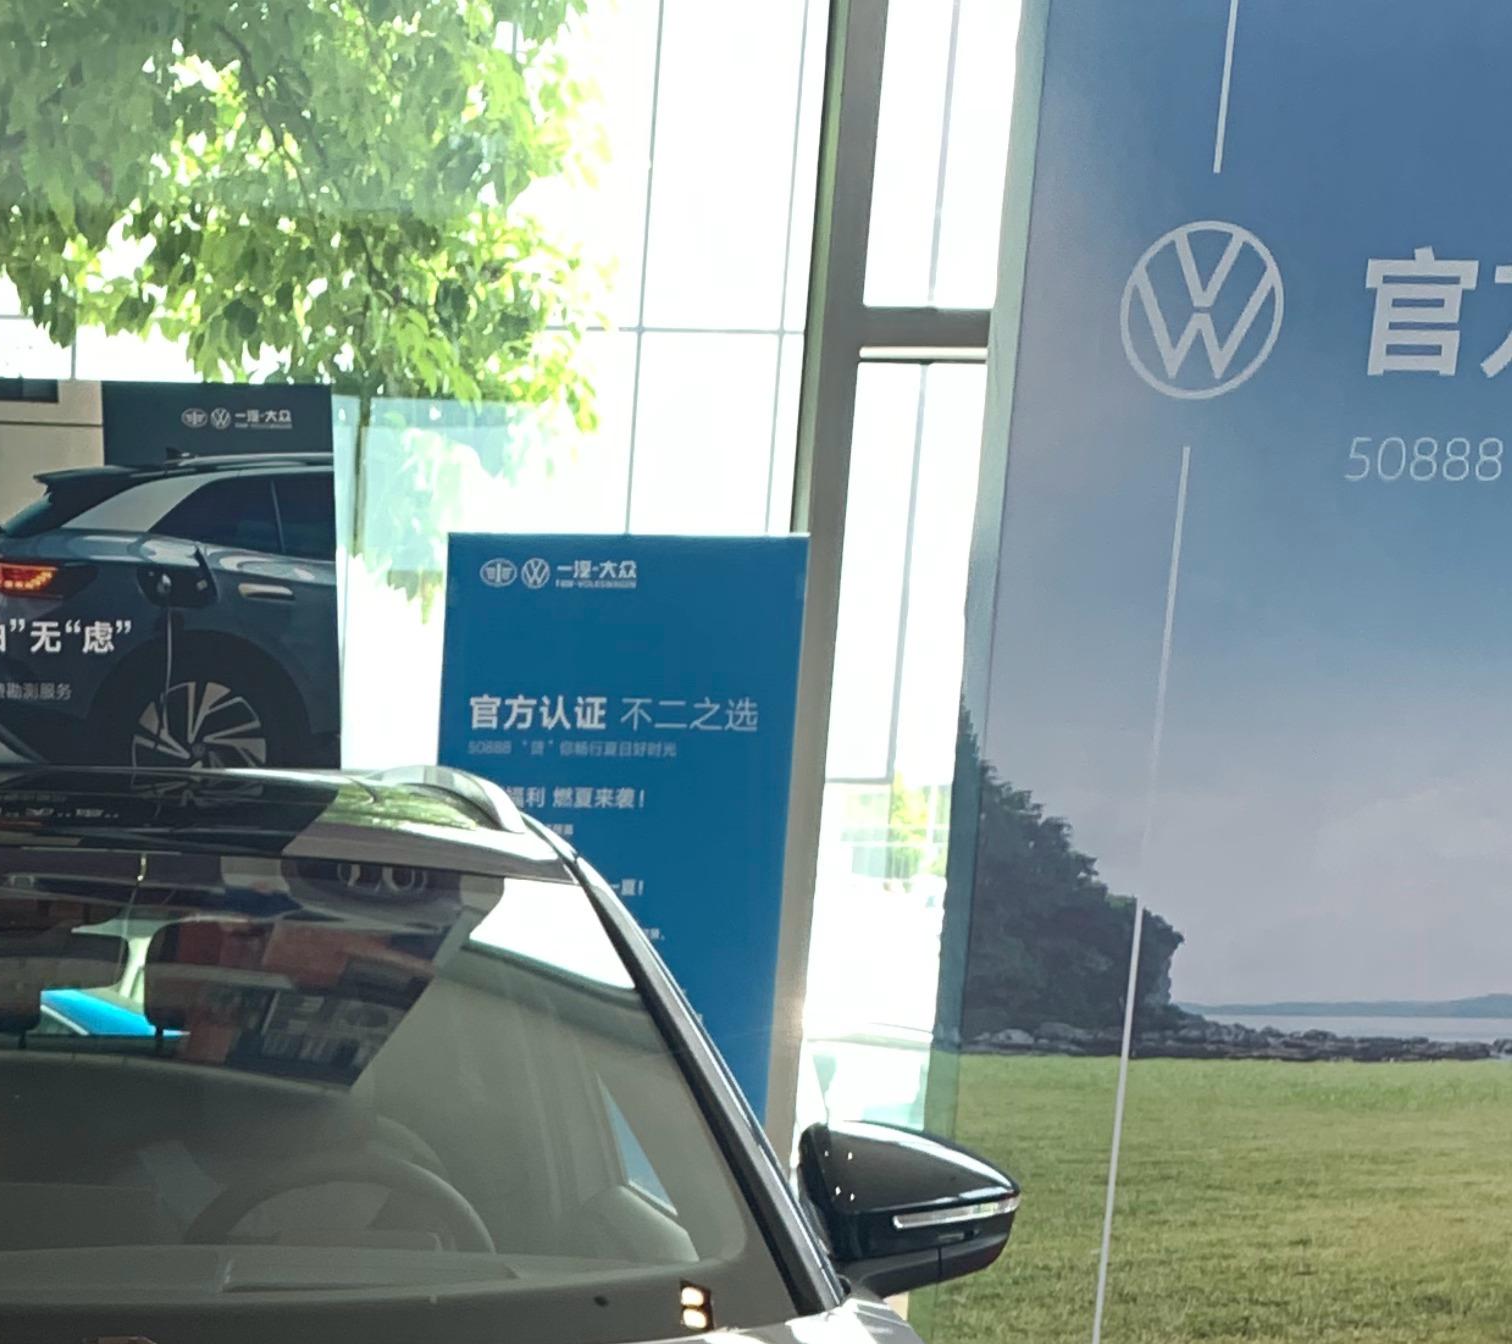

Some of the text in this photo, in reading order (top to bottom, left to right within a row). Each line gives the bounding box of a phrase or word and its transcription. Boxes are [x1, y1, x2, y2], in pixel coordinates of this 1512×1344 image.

[1365, 245, 1512, 379] 官
[1344, 436, 1504, 482] 50888
[469, 694, 758, 732] 官方认证 不二之选
